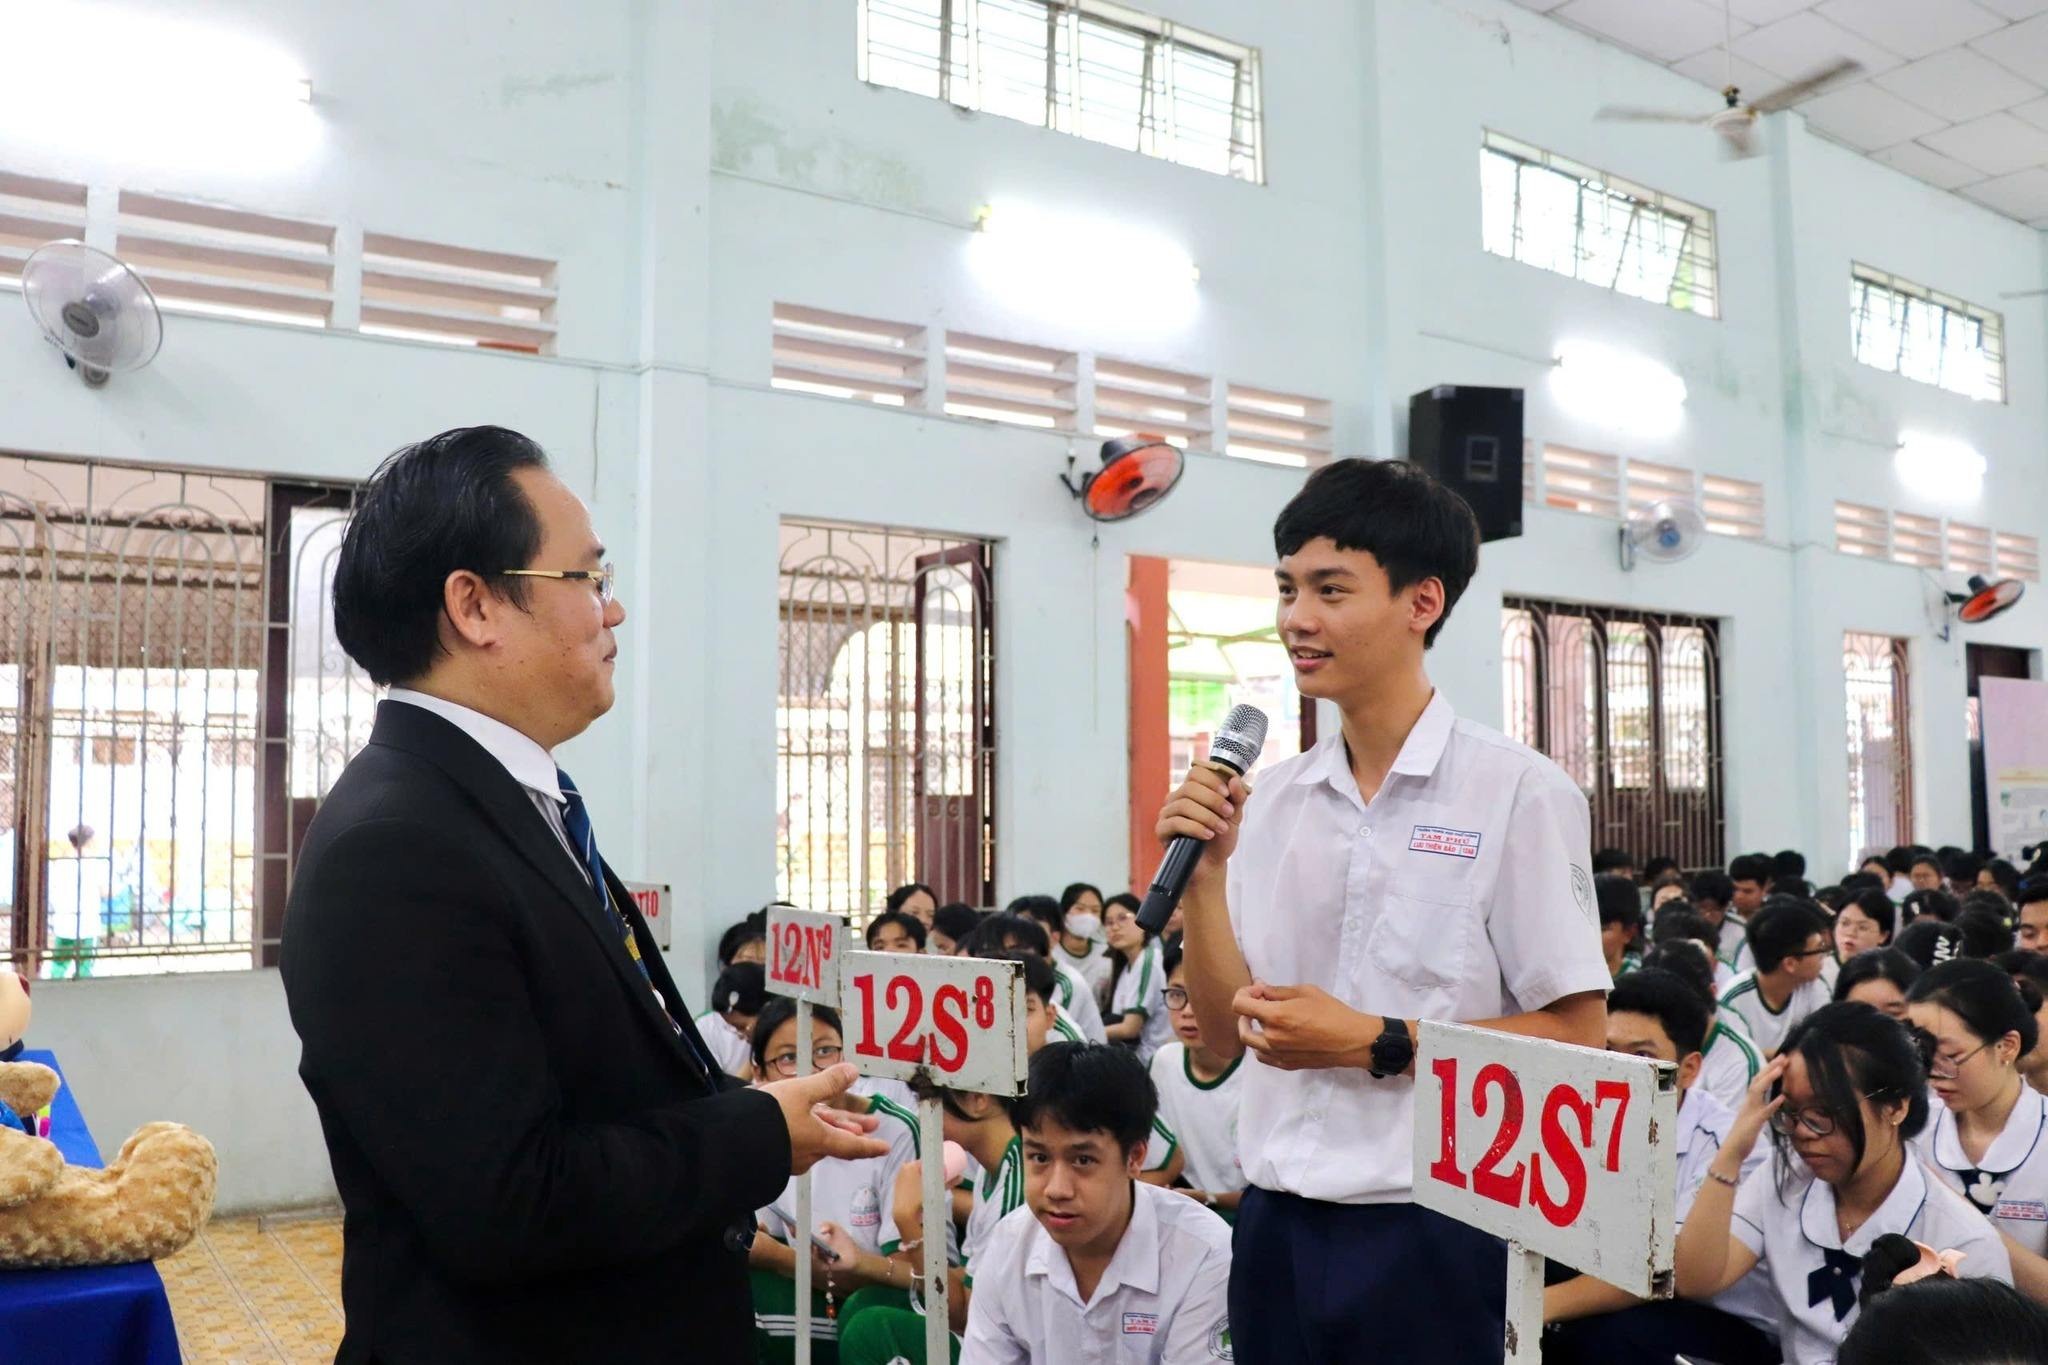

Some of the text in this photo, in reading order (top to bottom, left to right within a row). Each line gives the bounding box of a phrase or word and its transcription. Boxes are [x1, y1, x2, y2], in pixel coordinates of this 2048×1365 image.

[771, 922, 832, 989] 12N9
[853, 974, 995, 1072] 12S8
[1431, 1058, 1631, 1228] 12S7
